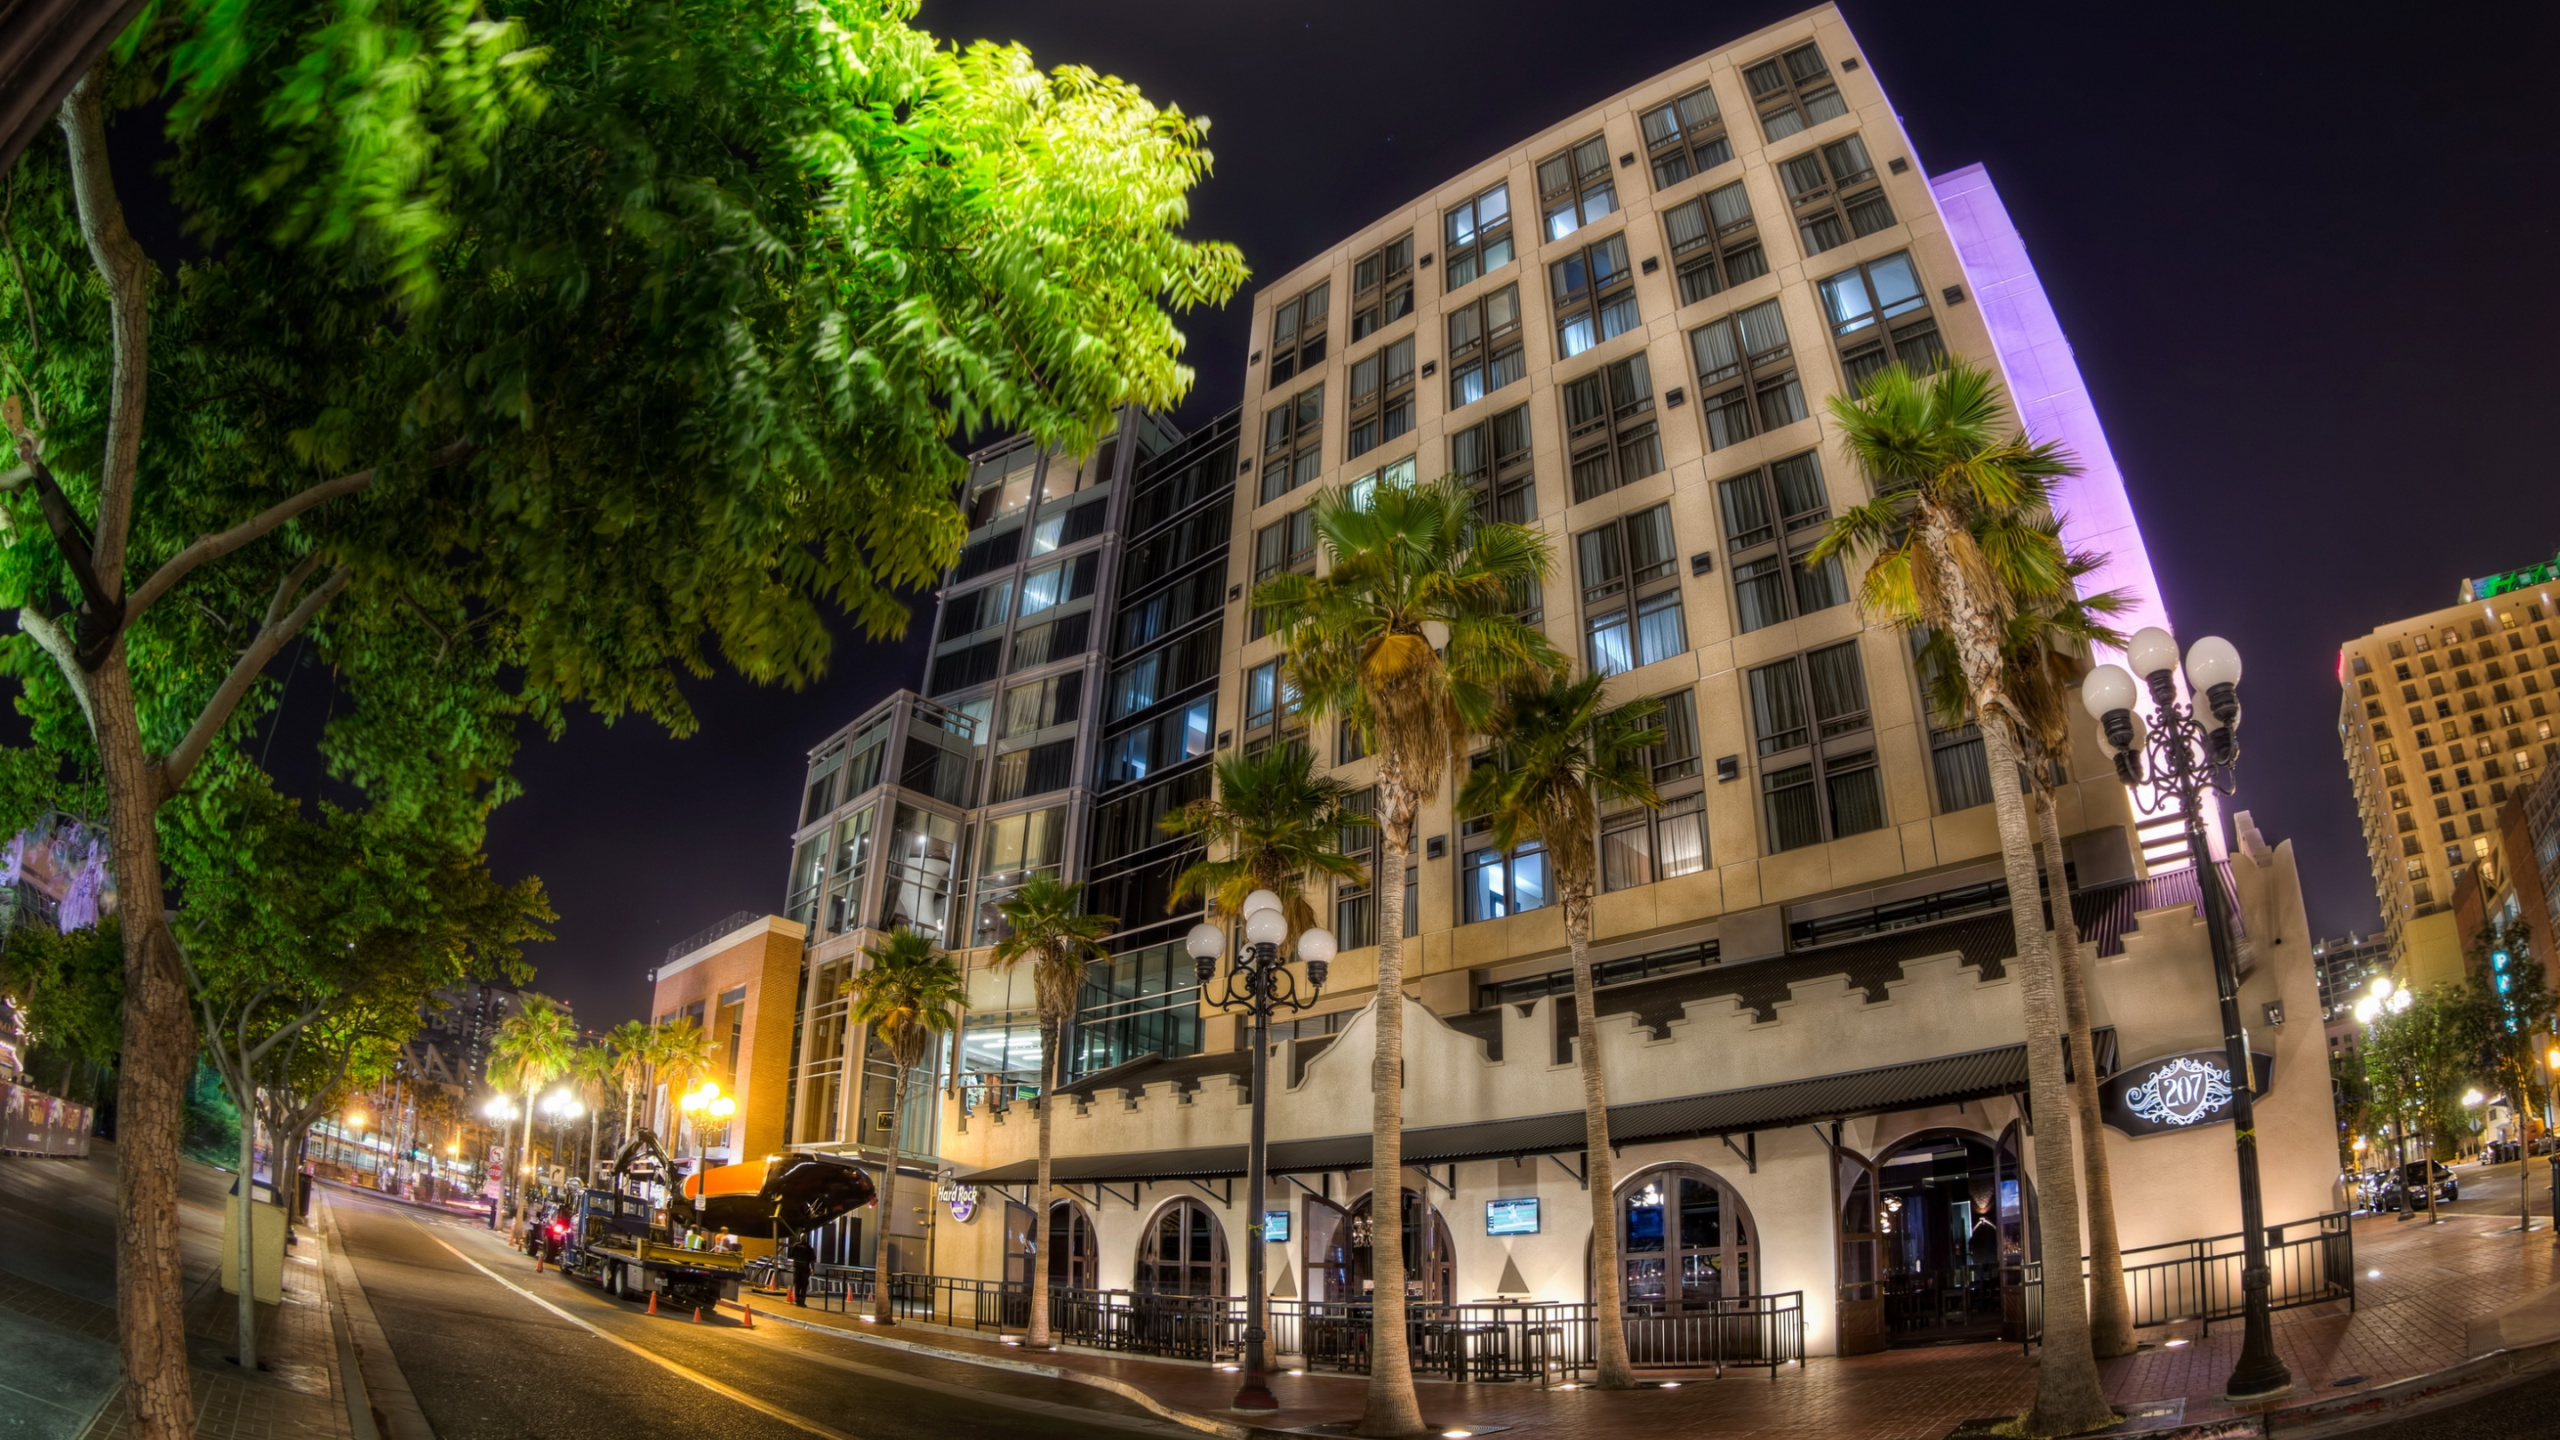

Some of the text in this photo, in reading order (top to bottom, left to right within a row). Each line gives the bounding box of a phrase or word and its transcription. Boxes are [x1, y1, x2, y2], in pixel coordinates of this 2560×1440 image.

[2163, 1072, 2202, 1108] 207
[489, 1168, 502, 1177] STOP
[937, 1184, 978, 1205] Hard Rock
